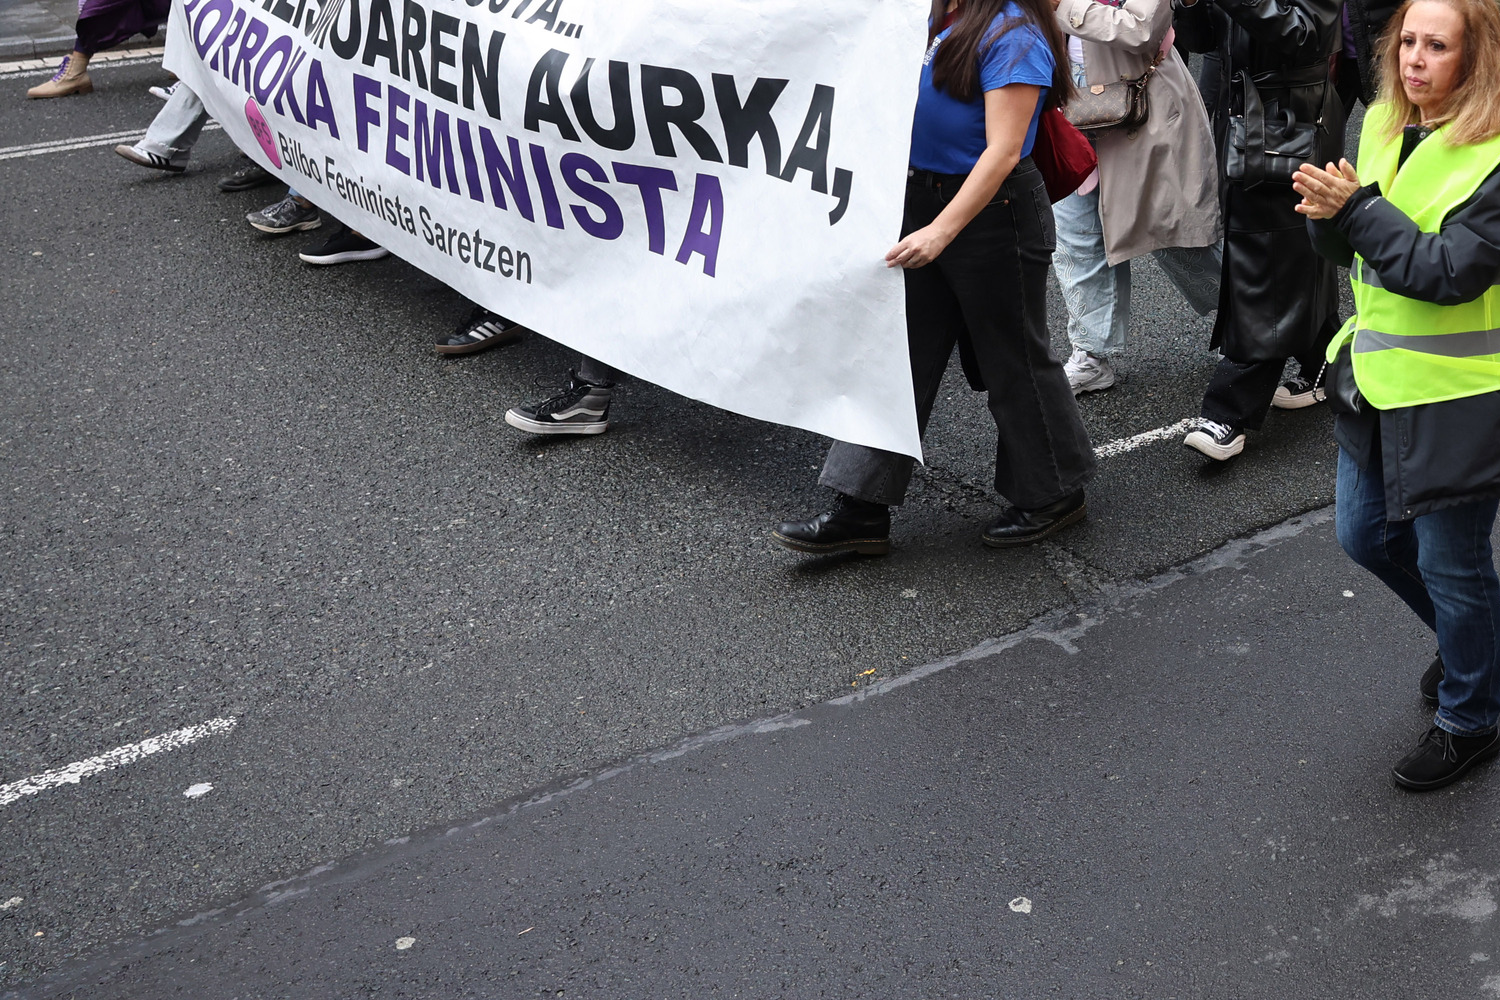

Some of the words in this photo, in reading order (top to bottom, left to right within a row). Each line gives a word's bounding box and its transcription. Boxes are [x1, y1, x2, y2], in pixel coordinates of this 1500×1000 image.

[278, 131, 323, 185] Bilbo
[325, 155, 417, 237] Feminista
[419, 205, 532, 285] Saretzen
[353, 72, 724, 279] FEMINISTA
[524, 47, 853, 227] AURKA,
